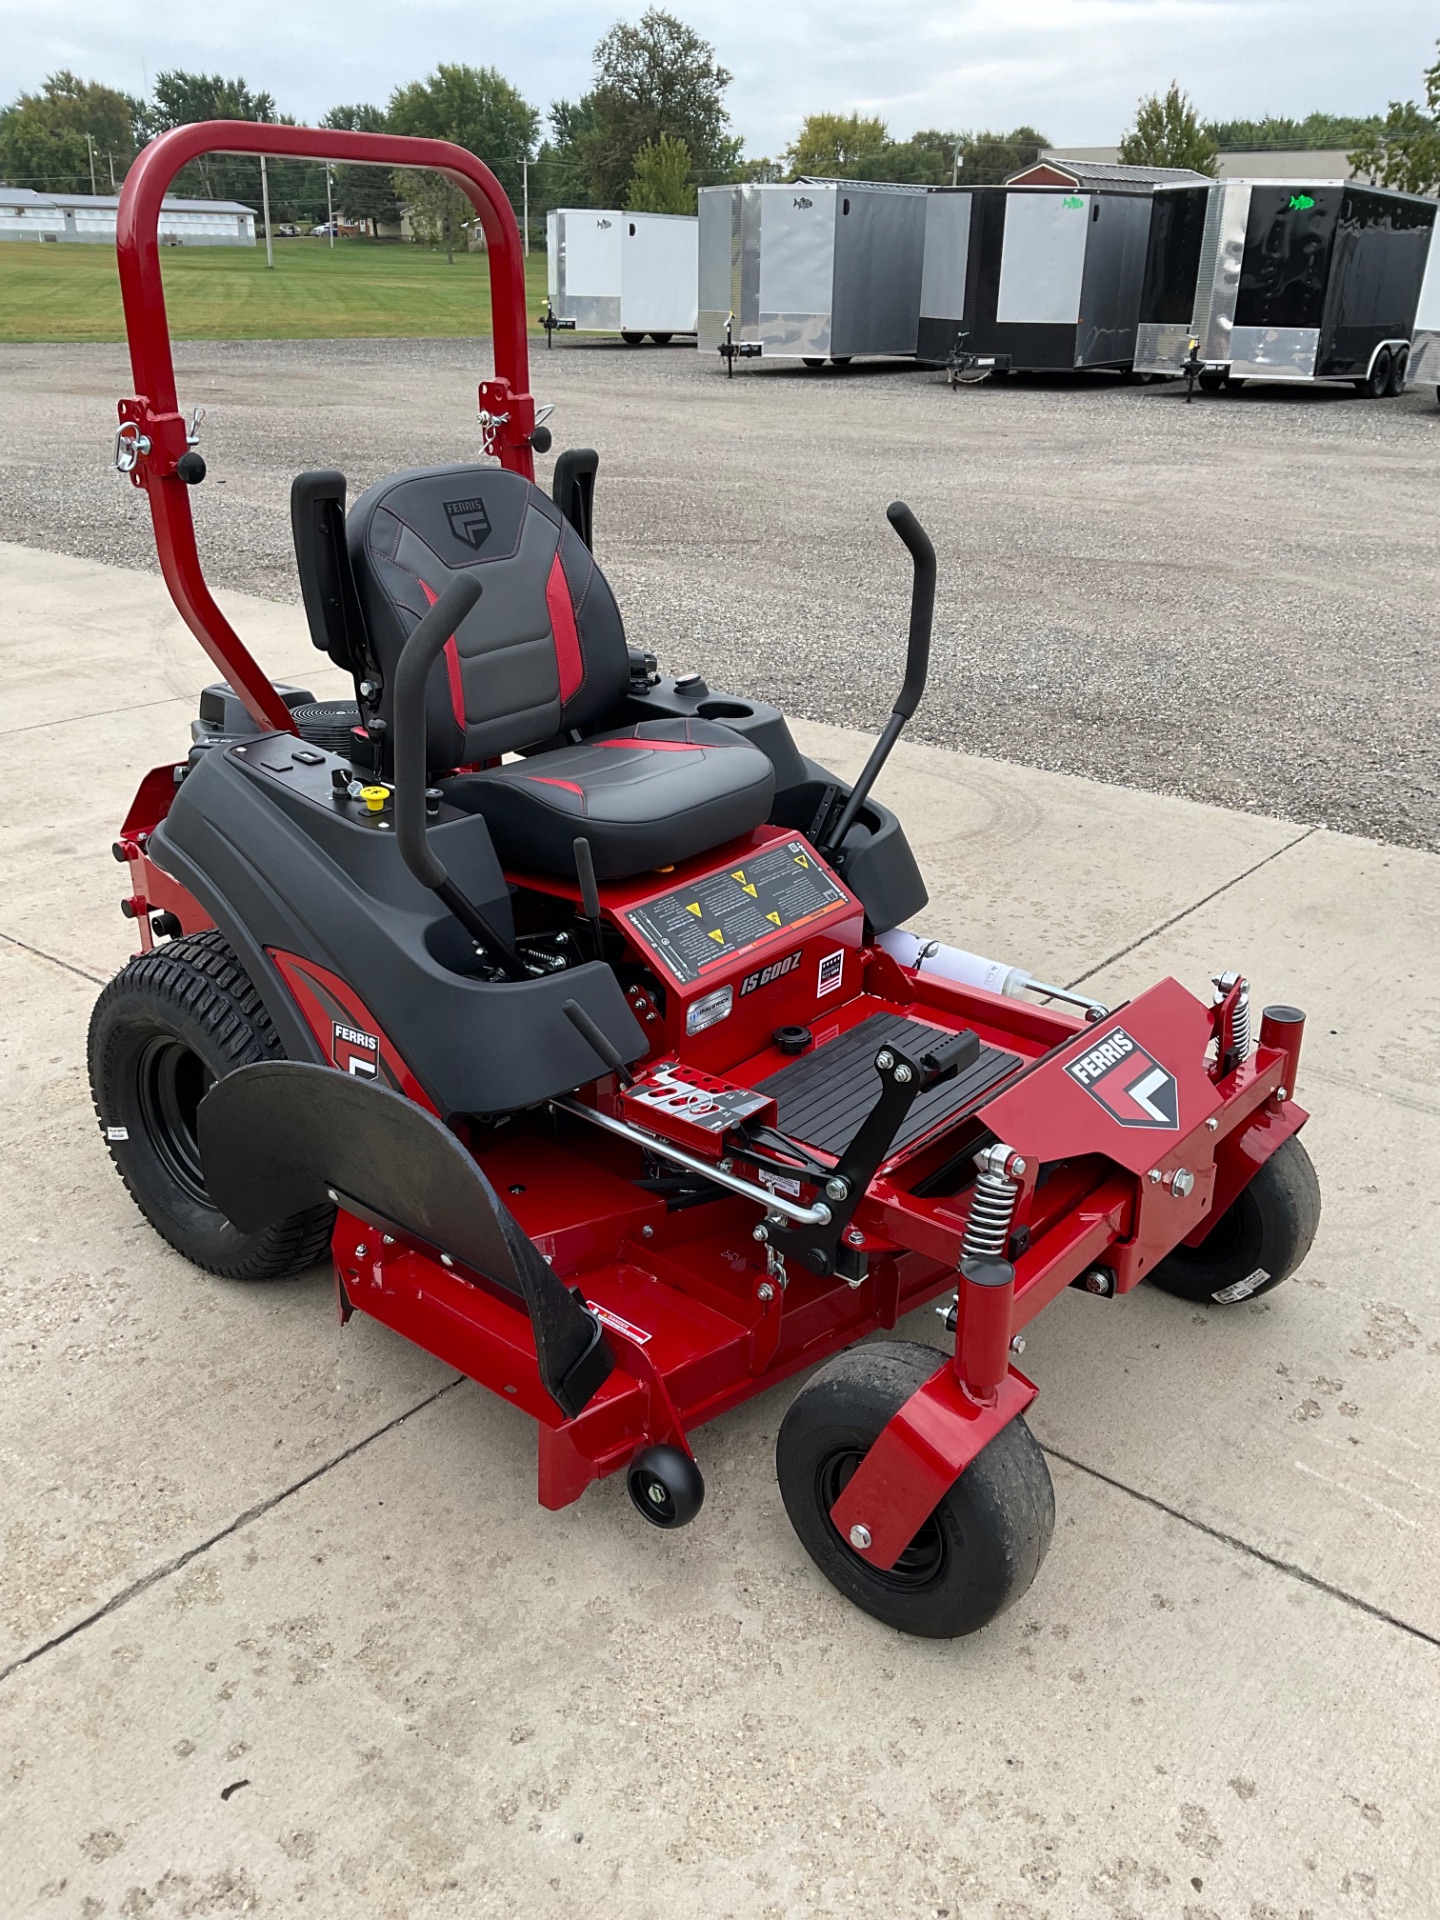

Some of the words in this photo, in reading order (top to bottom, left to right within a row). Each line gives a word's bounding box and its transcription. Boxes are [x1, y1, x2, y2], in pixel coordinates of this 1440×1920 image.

[447, 500, 482, 513] FERRIS
[740, 973, 760, 996] IS
[760, 951, 802, 986] 600Z
[335, 1024, 377, 1050] FERRIS
[1071, 1032, 1134, 1085] FERRIS
